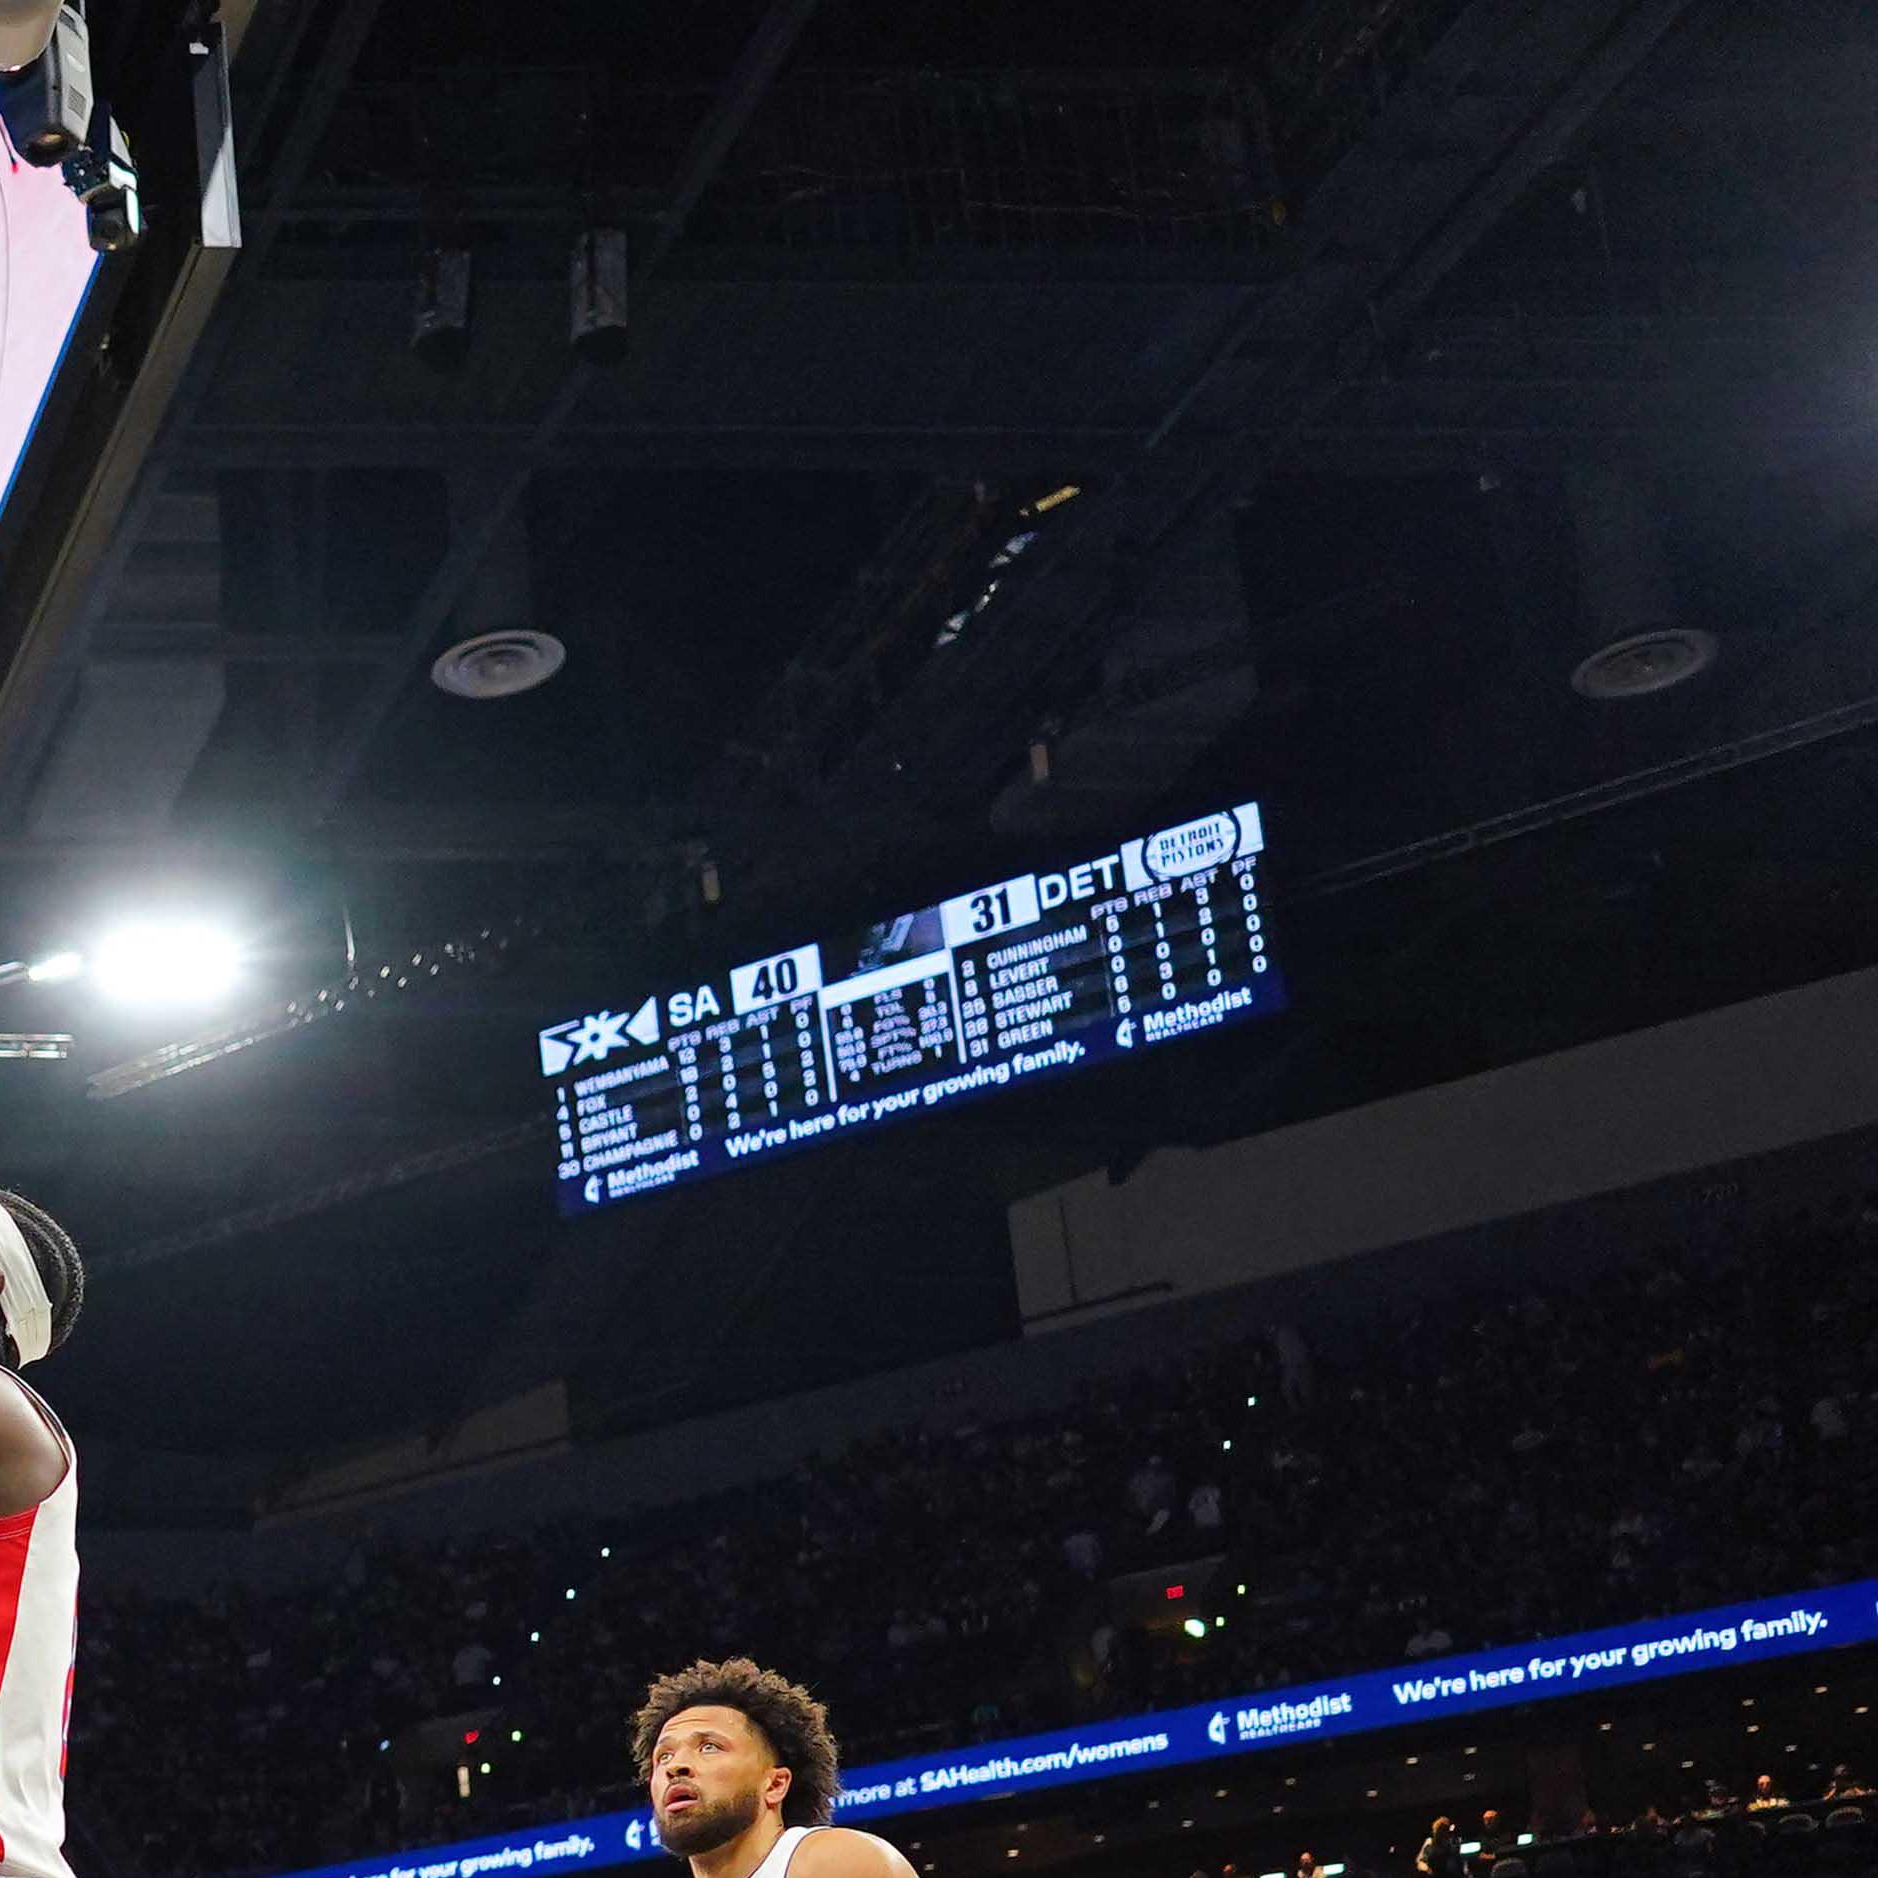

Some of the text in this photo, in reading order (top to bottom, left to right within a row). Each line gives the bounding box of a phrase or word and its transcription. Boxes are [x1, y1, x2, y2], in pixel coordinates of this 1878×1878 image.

[1159, 822, 1222, 851] DETROIT
[1161, 838, 1225, 868] PISTONS
[971, 854, 1120, 934] 31 DET
[986, 873, 1254, 970] CUNNINGHAM 0
[989, 893, 1257, 990] LEVERT 0 0
[992, 914, 1260, 1010] SASSER 0 0 0 0
[668, 958, 798, 1027] SA 40
[796, 1011, 809, 1029] 0
[995, 934, 1264, 1030] STEWART 0
[997, 954, 1267, 1049] GREEN 0 0 0
[1142, 986, 1253, 1034] Methodist
[576, 1031, 811, 1117] FOX 0
[579, 1073, 737, 1134] CASTLE 0
[580, 1080, 778, 1153] BRYANT 0 0
[582, 1088, 819, 1172] CHAMPAGNIE 0 0
[607, 1150, 700, 1187] Methodist
[724, 1127, 787, 1158] We're
[788, 1113, 836, 1141] here
[837, 1103, 870, 1126] for
[872, 1087, 920, 1121] your
[922, 1060, 1010, 1105] growing
[1011, 1040, 1087, 1075] family.
[1392, 1609, 1829, 1706] We're here for your growing family.
[1236, 1692, 1354, 1733] Methodist
[840, 1731, 1169, 1808] more at SAHealth.com/womens
[461, 1845, 533, 1878] growing
[534, 1834, 595, 1866] family.
